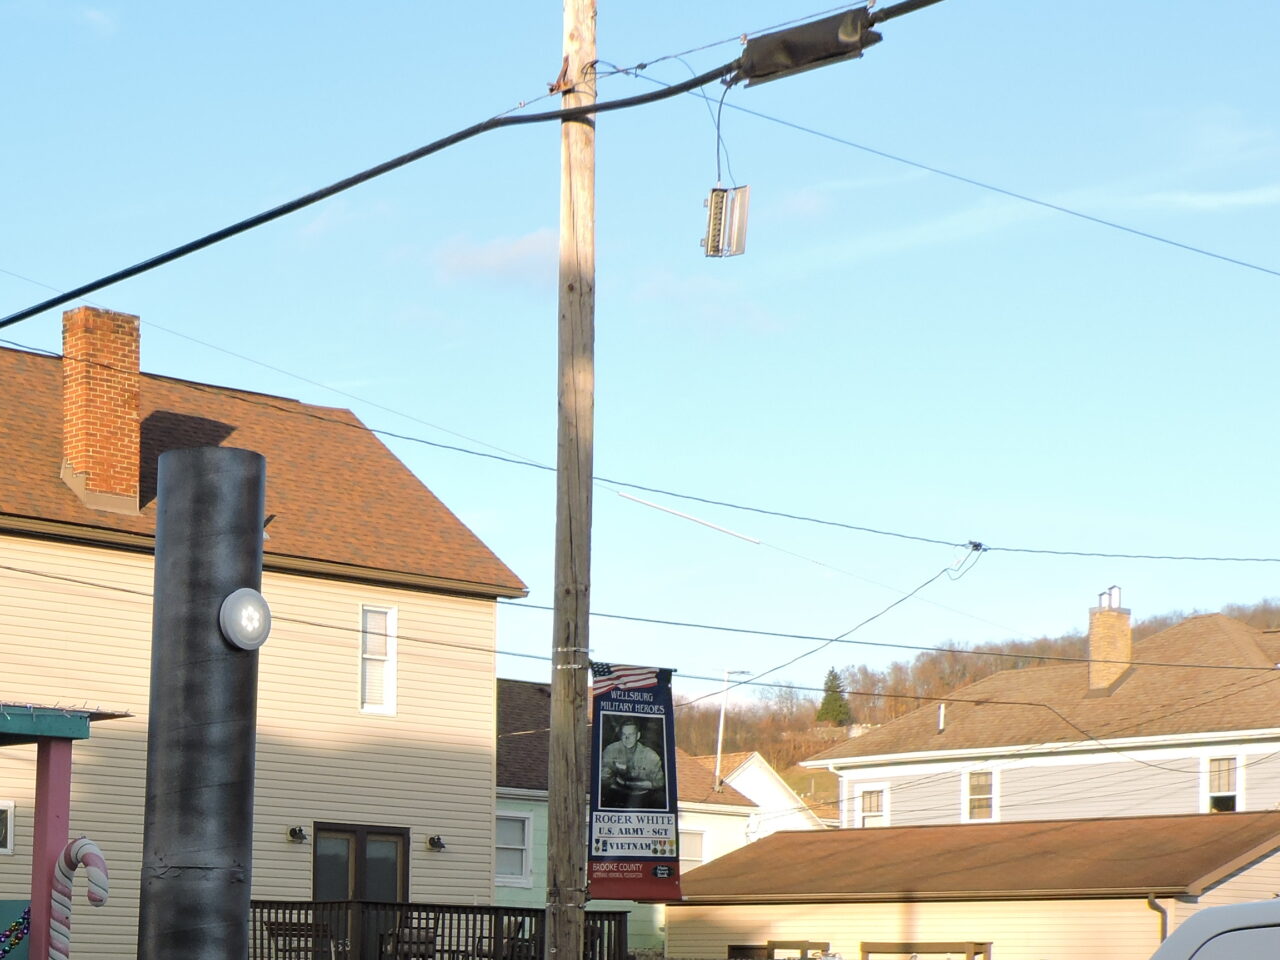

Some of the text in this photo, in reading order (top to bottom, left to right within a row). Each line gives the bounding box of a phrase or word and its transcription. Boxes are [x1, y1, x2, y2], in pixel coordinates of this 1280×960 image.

[611, 690, 653, 702] WELLSBURG
[600, 701, 665, 714] MILITARY HEROES
[595, 814, 674, 825] ROGER WHITE
[598, 827, 615, 835] U.S.
[617, 828, 645, 836] ARMY
[652, 828, 669, 836] SGT
[609, 842, 652, 851] VIETNAM
[592, 863, 643, 871] BROOKE COUNTY
